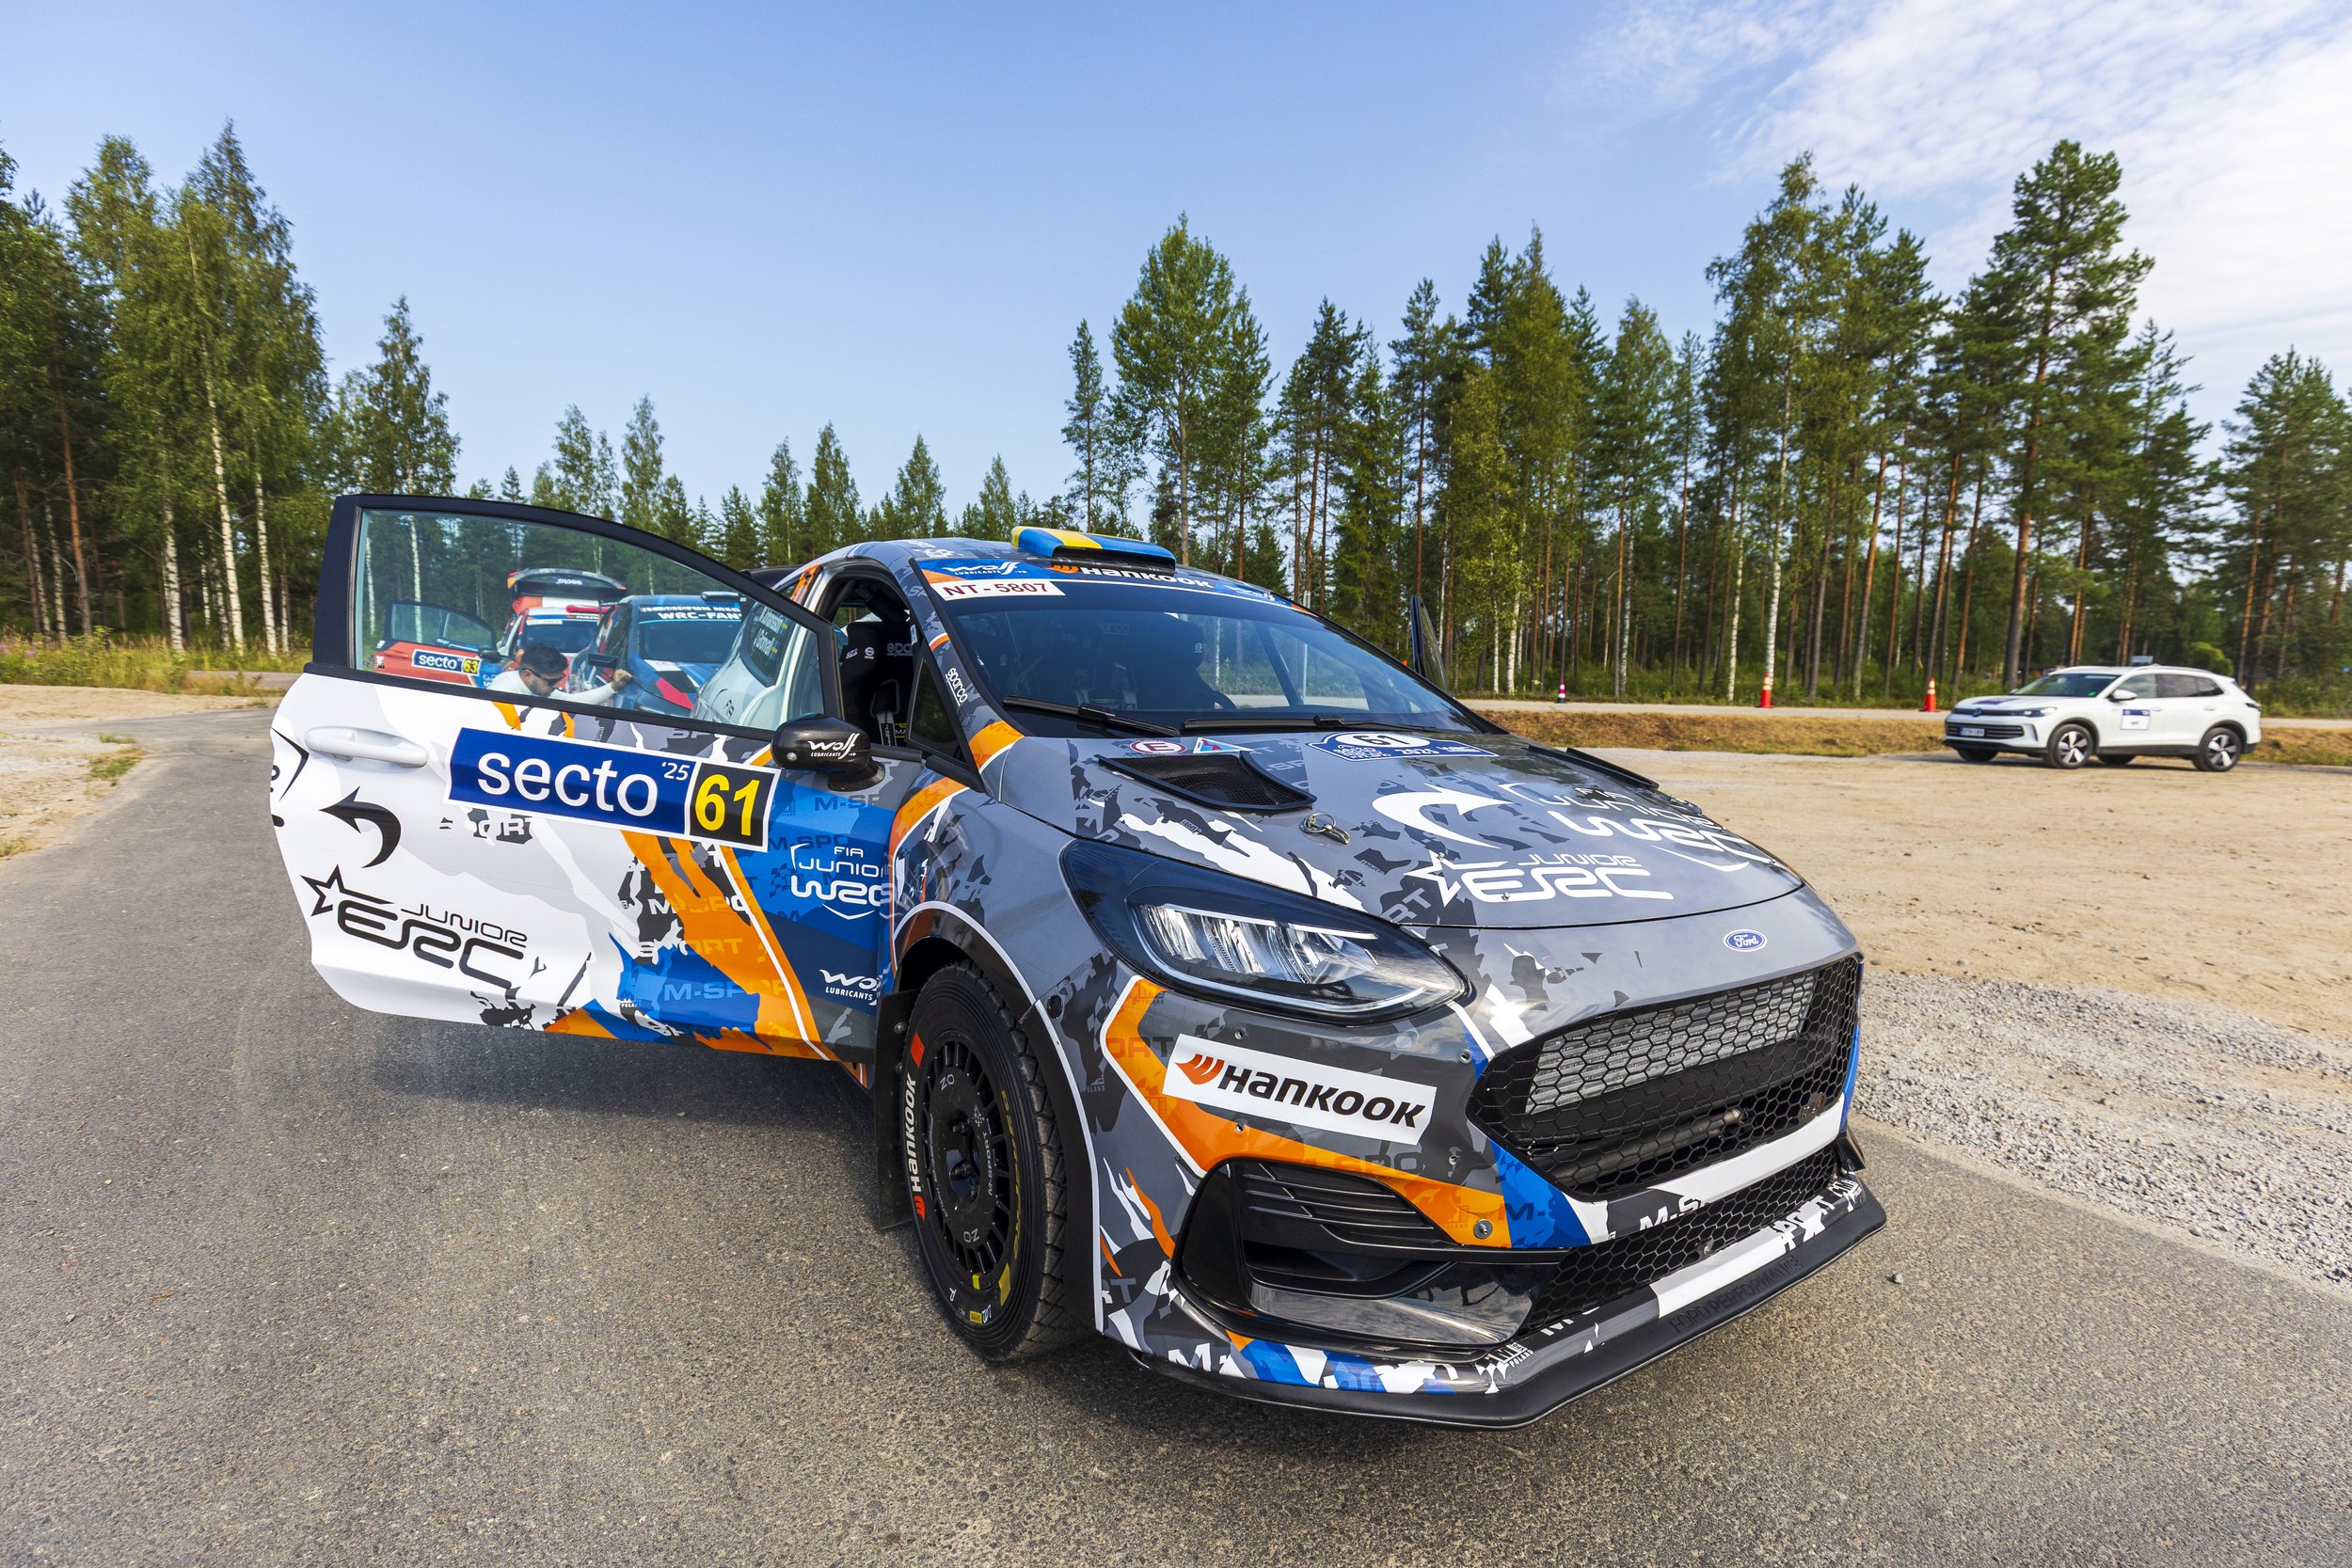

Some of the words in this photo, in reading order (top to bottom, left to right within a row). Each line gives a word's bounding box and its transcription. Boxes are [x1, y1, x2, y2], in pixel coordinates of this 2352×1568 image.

[1080, 566, 1216, 588] Hankook
[418, 654, 457, 670] secto
[462, 658, 480, 673] 63
[946, 667, 969, 705] sparco
[1352, 735, 1411, 746] 61
[476, 751, 659, 817] secto
[694, 773, 760, 836] 61
[834, 846, 864, 858] FIA
[1517, 853, 1643, 867] JUNIOR
[798, 857, 883, 879] JUNIO
[1460, 866, 1675, 903] ERC
[400, 903, 528, 948] JUNIOR
[337, 899, 525, 990] ERC
[1733, 933, 1759, 948] Ford
[825, 986, 873, 1001] LUBRICANTS
[1217, 1064, 1426, 1129] Hankook
[904, 1071, 922, 1194] Hankook
[1669, 1304, 1709, 1334] FORD
[1709, 1254, 1805, 1313] PERFORMANCE
[1508, 1349, 1534, 1368] POLAND
